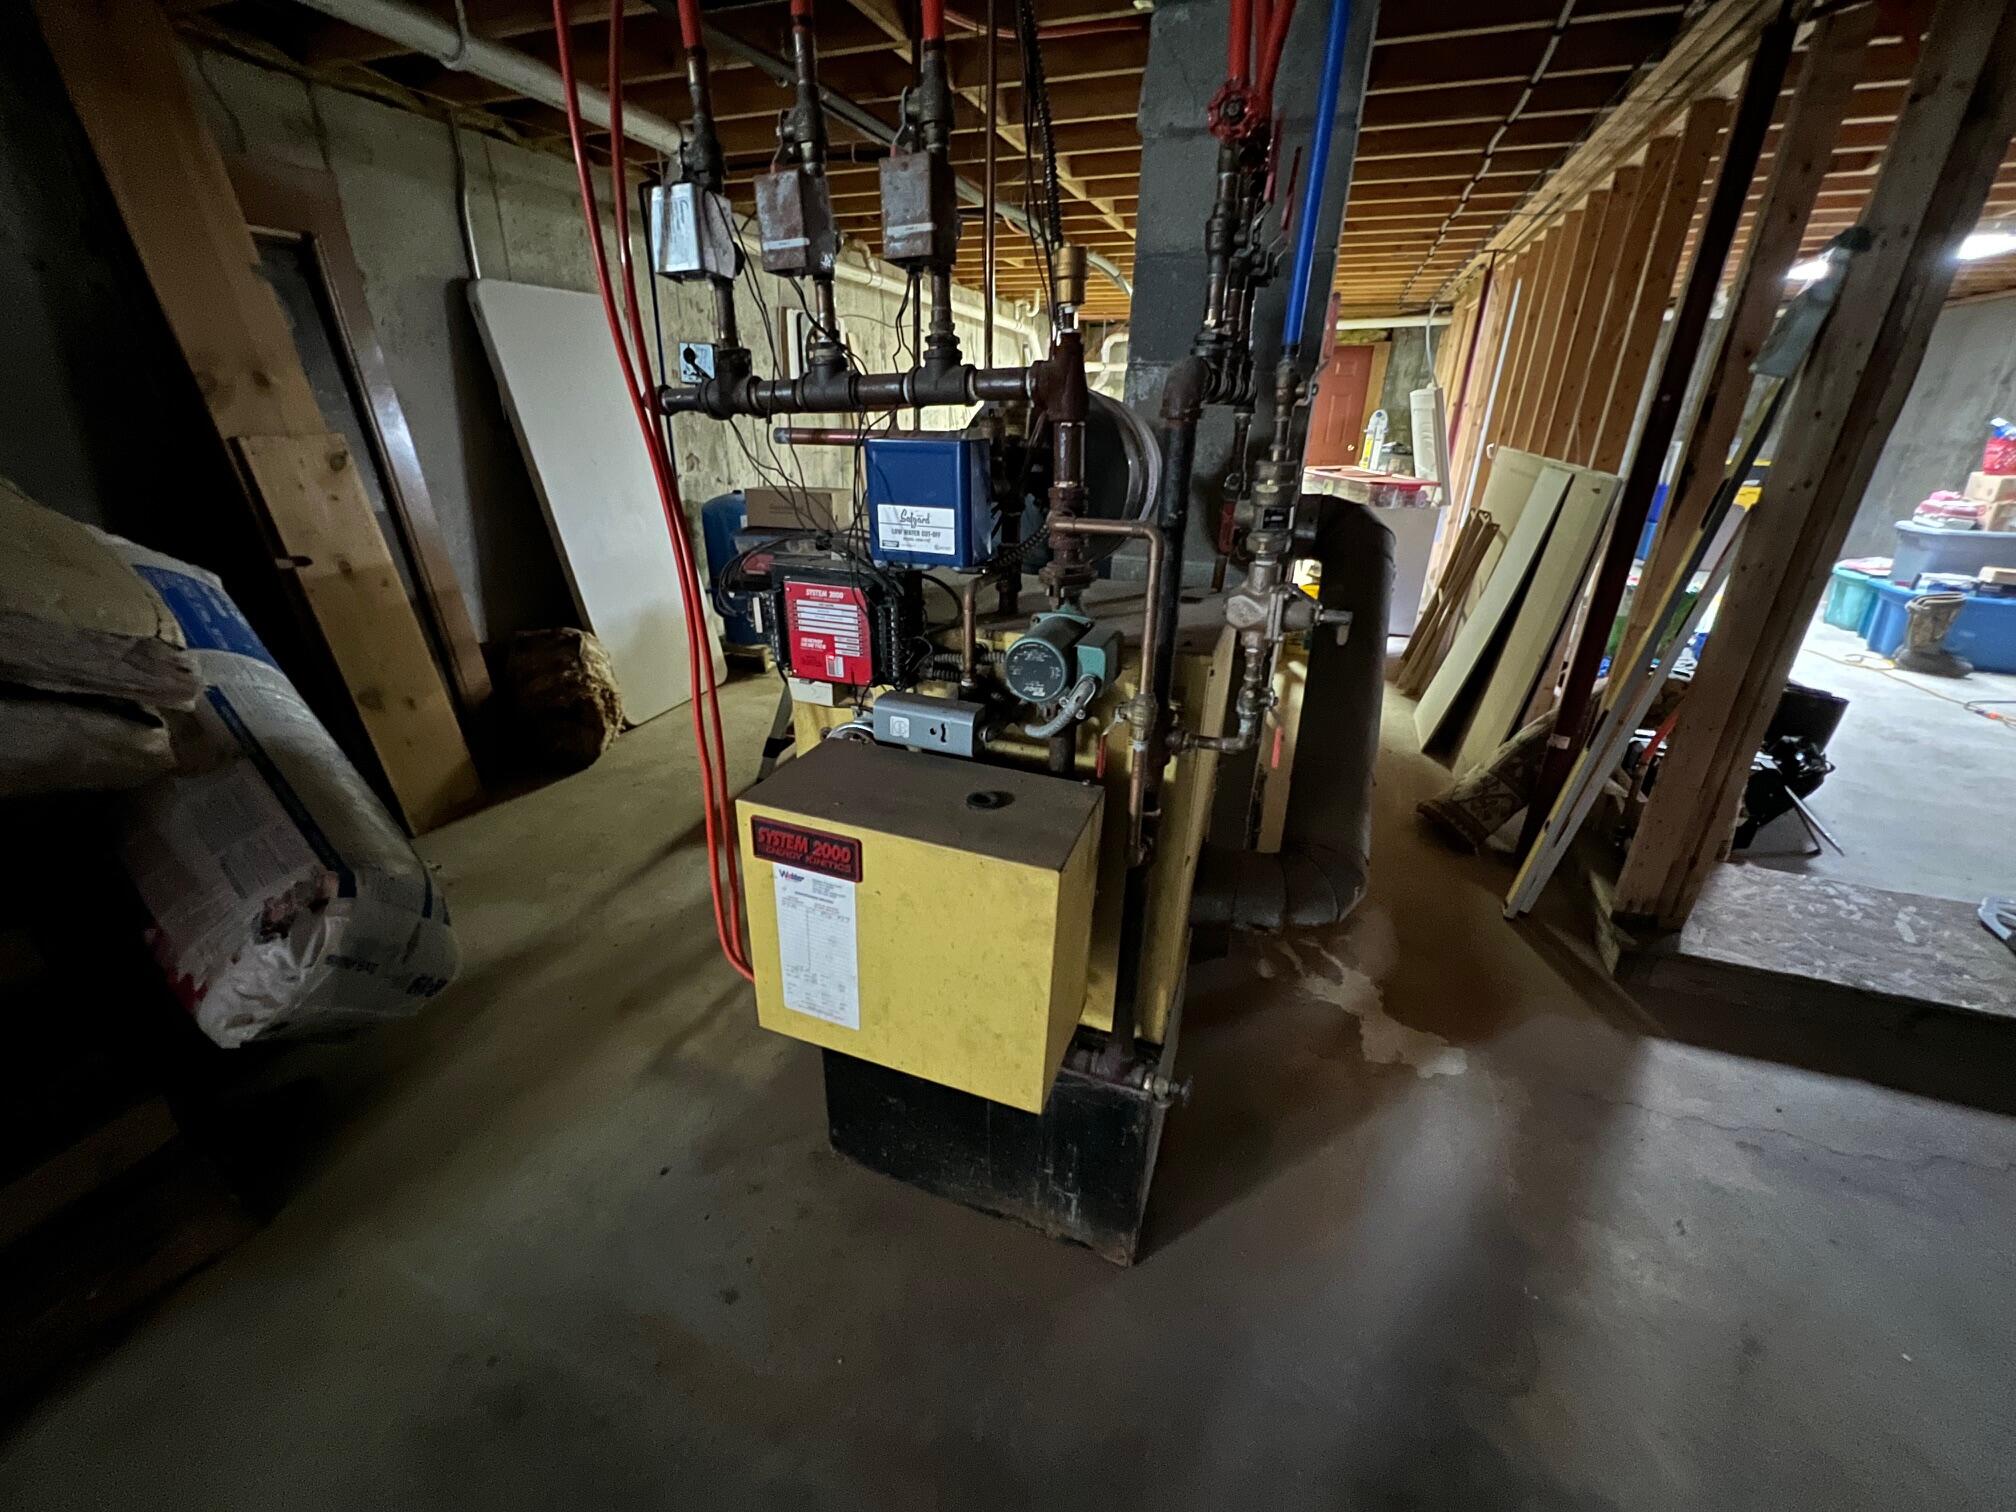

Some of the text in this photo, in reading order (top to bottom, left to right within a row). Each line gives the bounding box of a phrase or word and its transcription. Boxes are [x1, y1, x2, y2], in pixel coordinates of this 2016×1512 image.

[904, 529, 920, 537] WATER
[921, 530, 941, 538] CUT-OFF
[806, 588, 828, 598] SYSTEM
[829, 591, 844, 599] 2000
[758, 827, 851, 864] SYSTEM 2000
